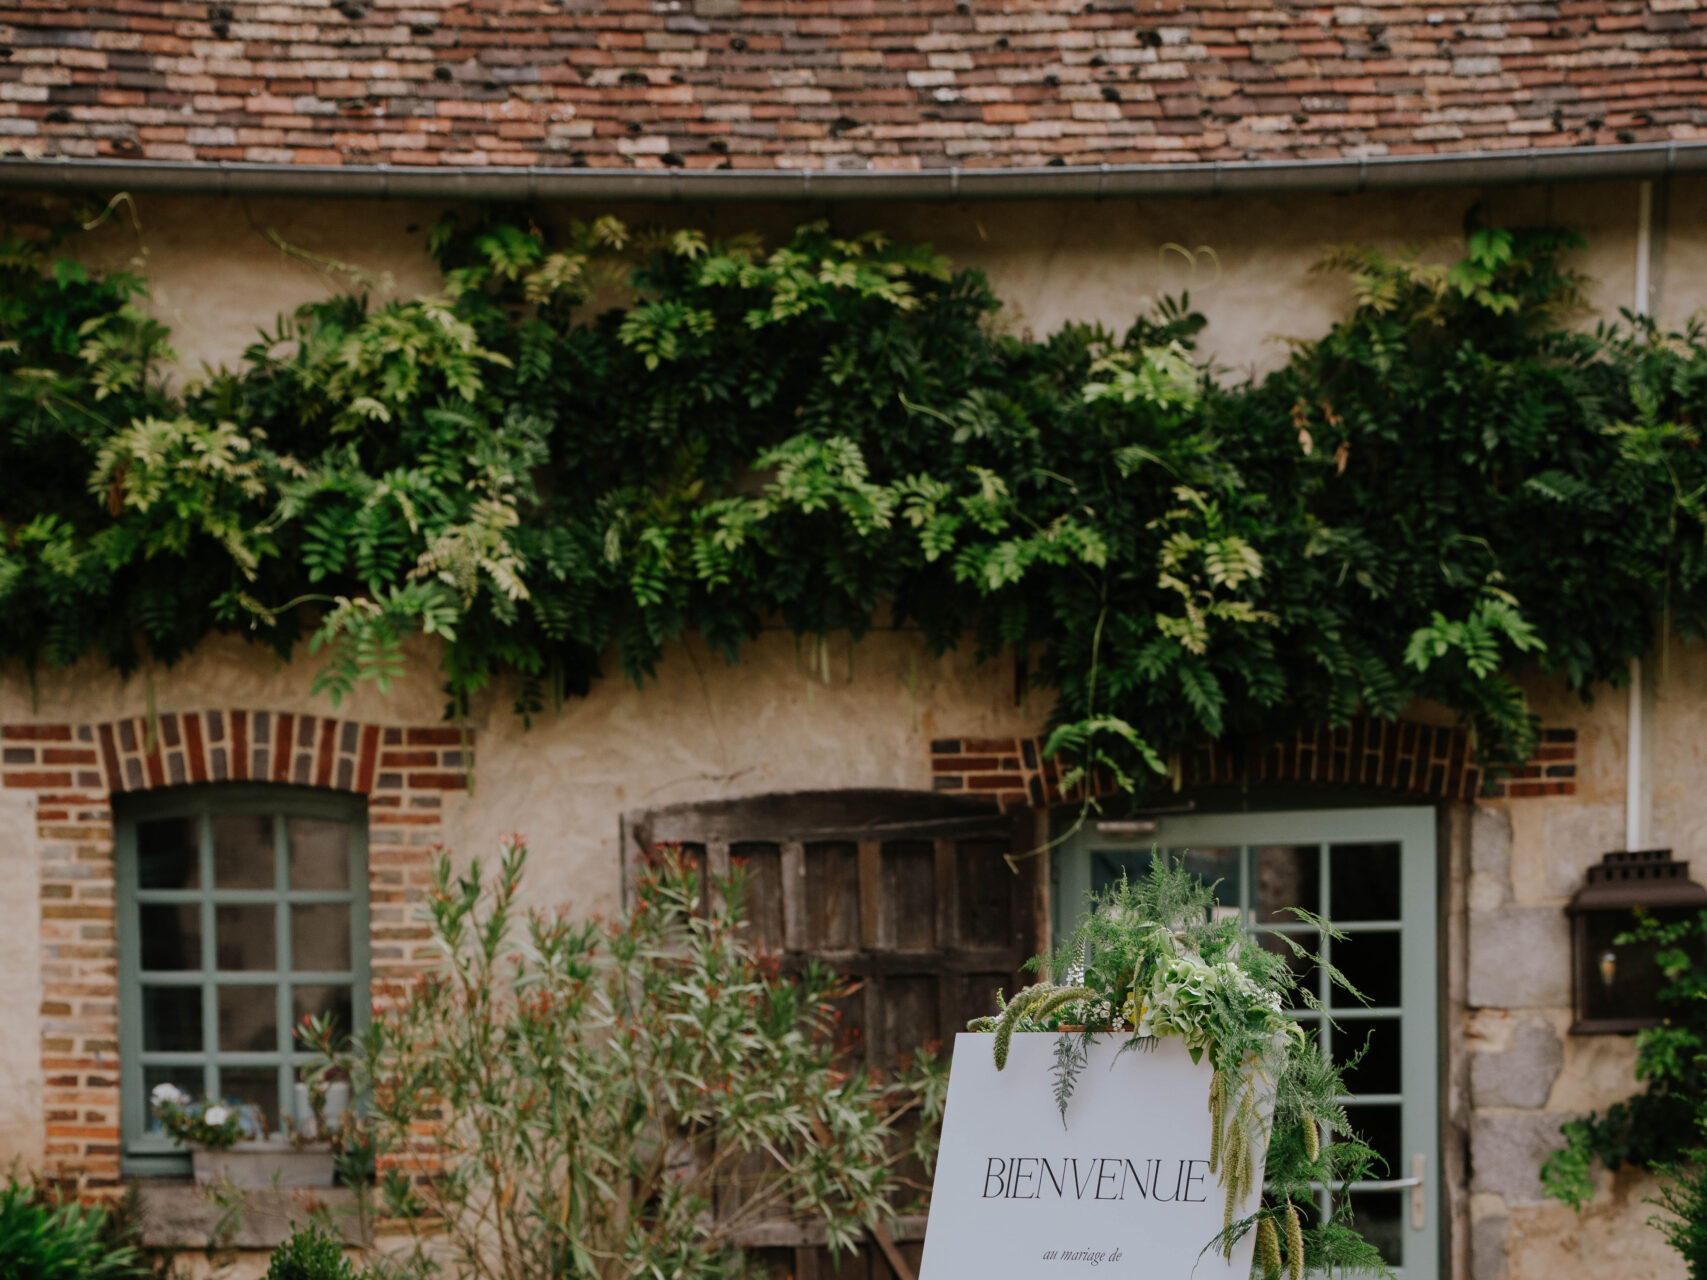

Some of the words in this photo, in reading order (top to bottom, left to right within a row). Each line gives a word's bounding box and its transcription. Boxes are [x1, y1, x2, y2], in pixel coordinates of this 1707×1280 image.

[981, 1157, 1210, 1202] BIENVENUE
[1042, 1250, 1057, 1260] au
[1060, 1247, 1106, 1266] mariage
[1108, 1247, 1123, 1262] de
